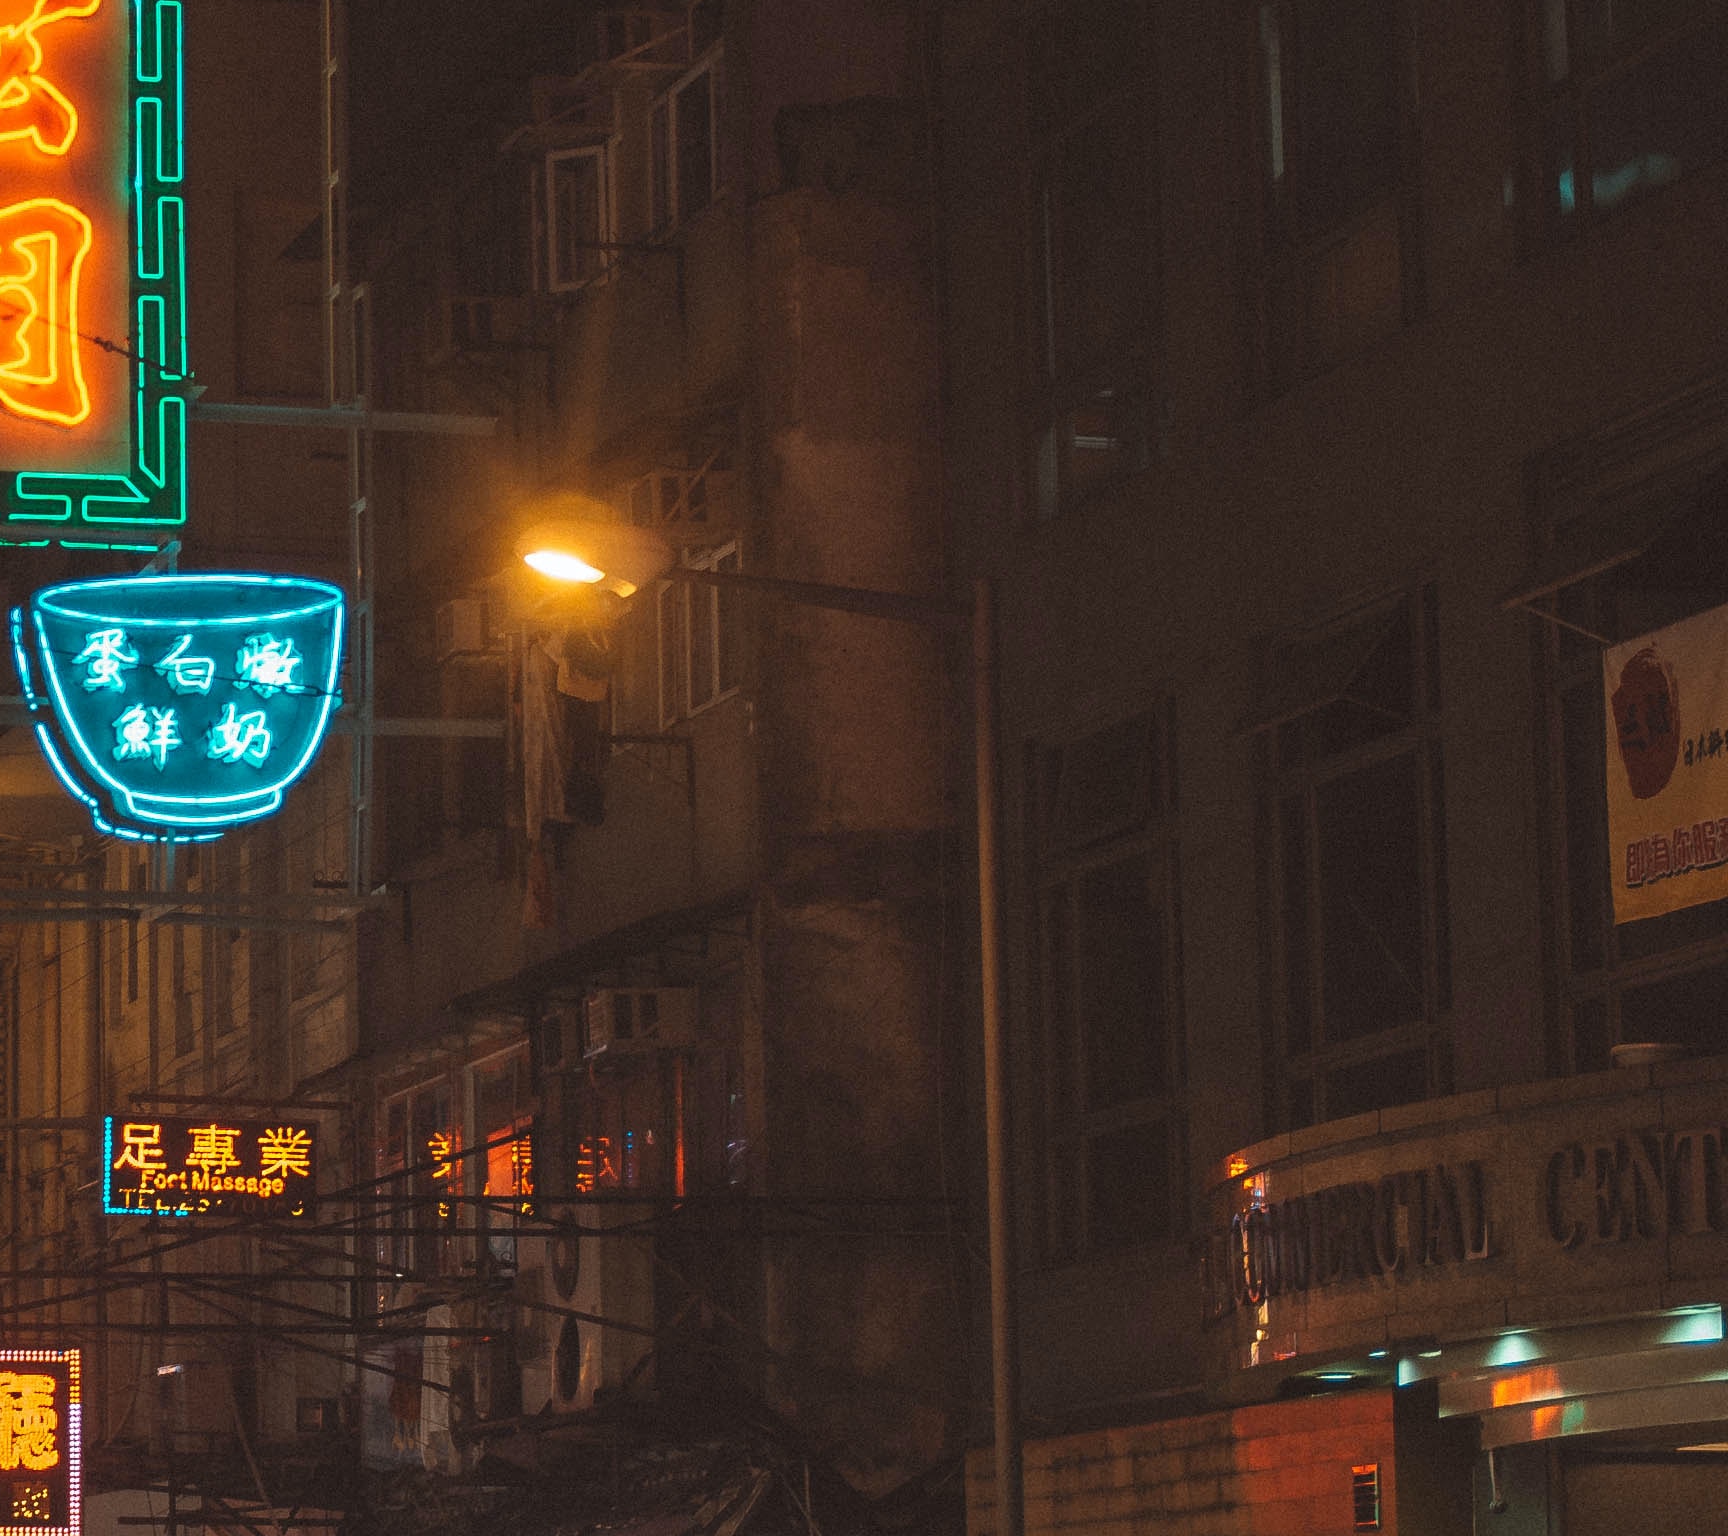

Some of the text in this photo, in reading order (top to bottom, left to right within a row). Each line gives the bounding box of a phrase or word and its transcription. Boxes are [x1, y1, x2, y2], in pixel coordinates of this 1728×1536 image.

[72, 628, 304, 697] 蛋白燉
[111, 701, 273, 769] 鮮奶
[191, 1170, 285, 1199] Massage
